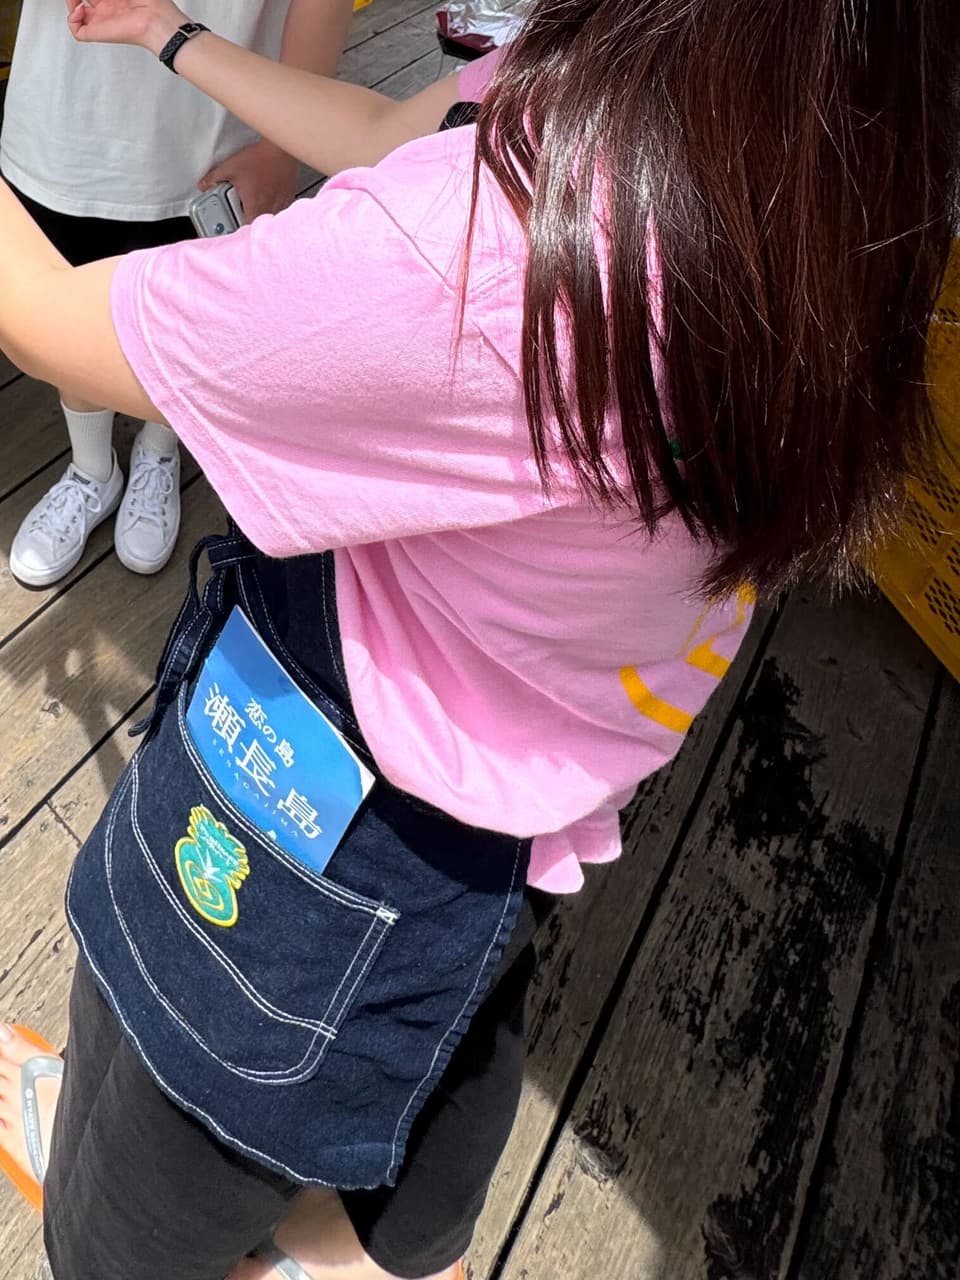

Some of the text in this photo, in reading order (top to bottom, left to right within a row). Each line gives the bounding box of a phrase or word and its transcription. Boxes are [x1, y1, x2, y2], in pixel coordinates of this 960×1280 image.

[203, 682, 322, 839] 瀬長島
[244, 698, 295, 768] 恋の島
